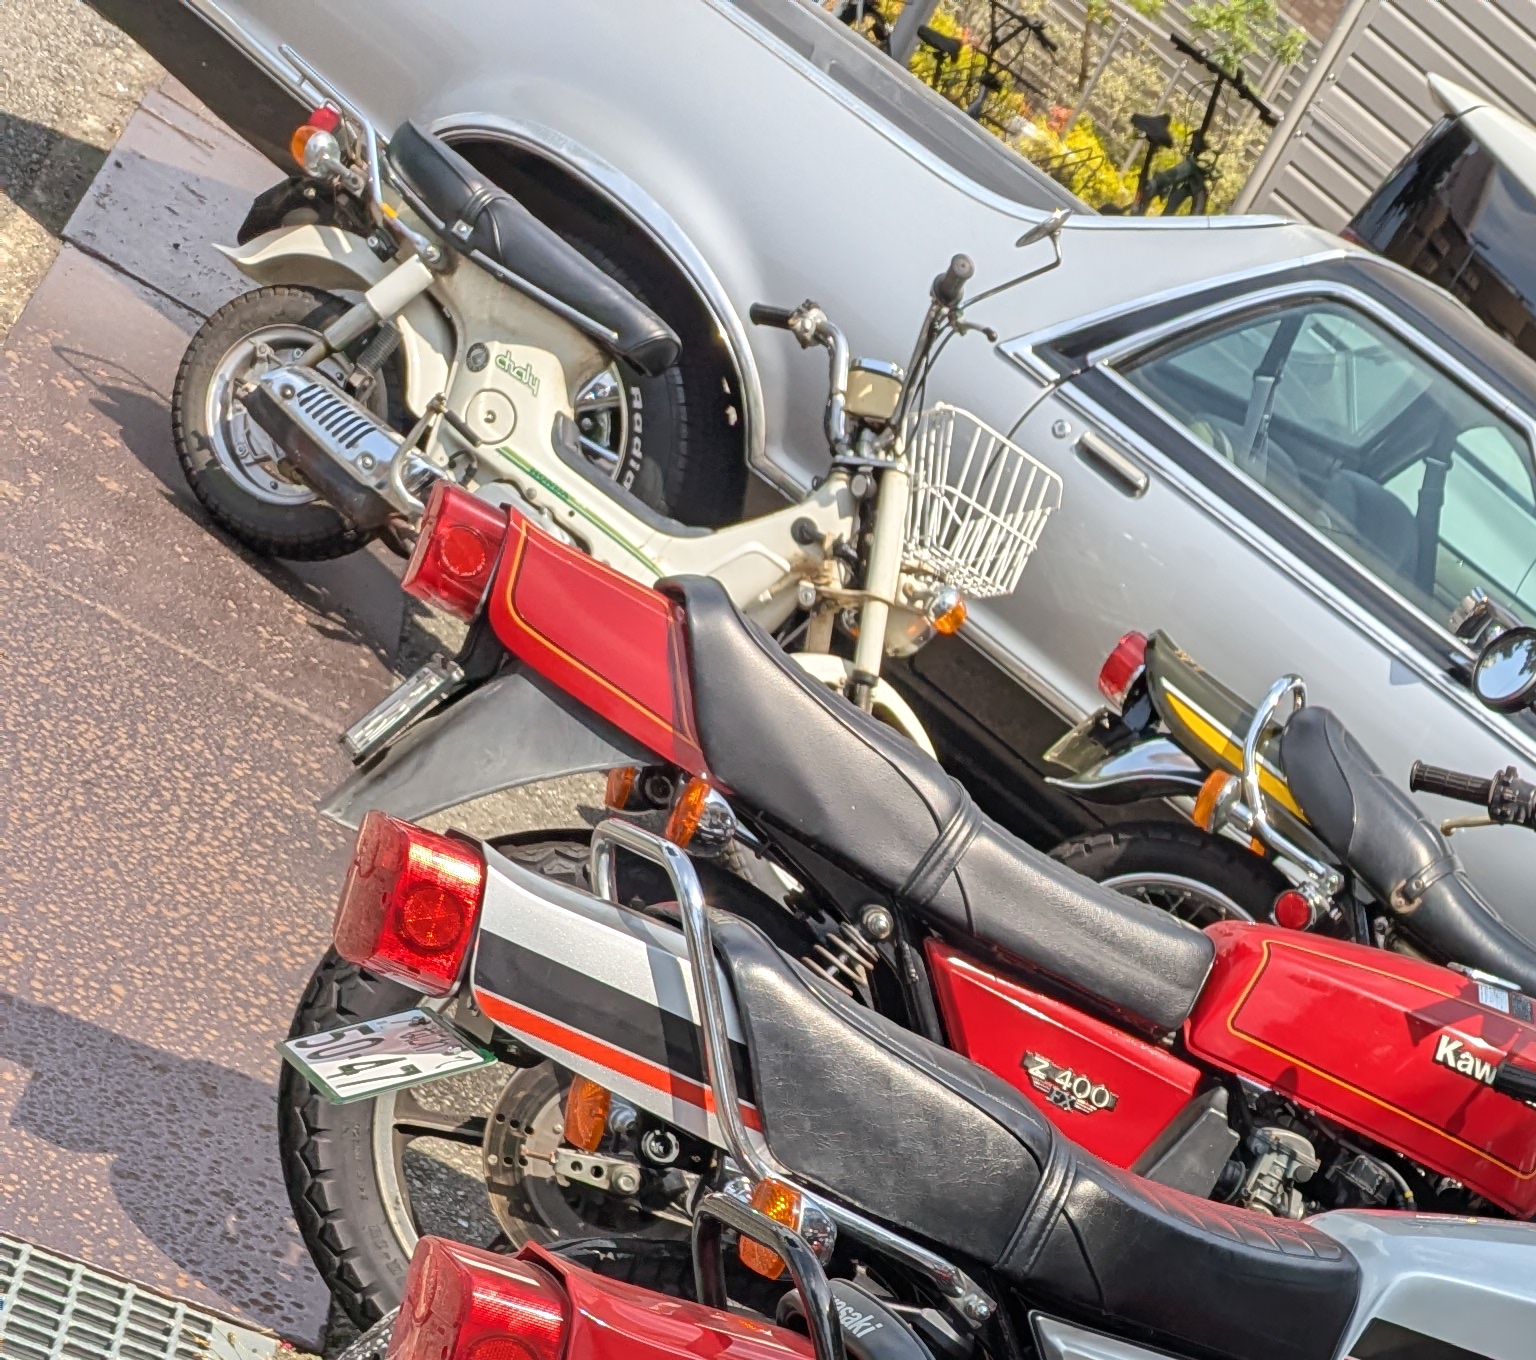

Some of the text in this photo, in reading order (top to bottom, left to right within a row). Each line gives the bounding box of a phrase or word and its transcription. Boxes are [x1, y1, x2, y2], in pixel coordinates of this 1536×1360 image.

[495, 350, 541, 398] chaly
[624, 386, 643, 491] Radia
[294, 1024, 424, 1089] 50-47
[1028, 1055, 1110, 1108] Z 400
[833, 1294, 884, 1339] asaki
